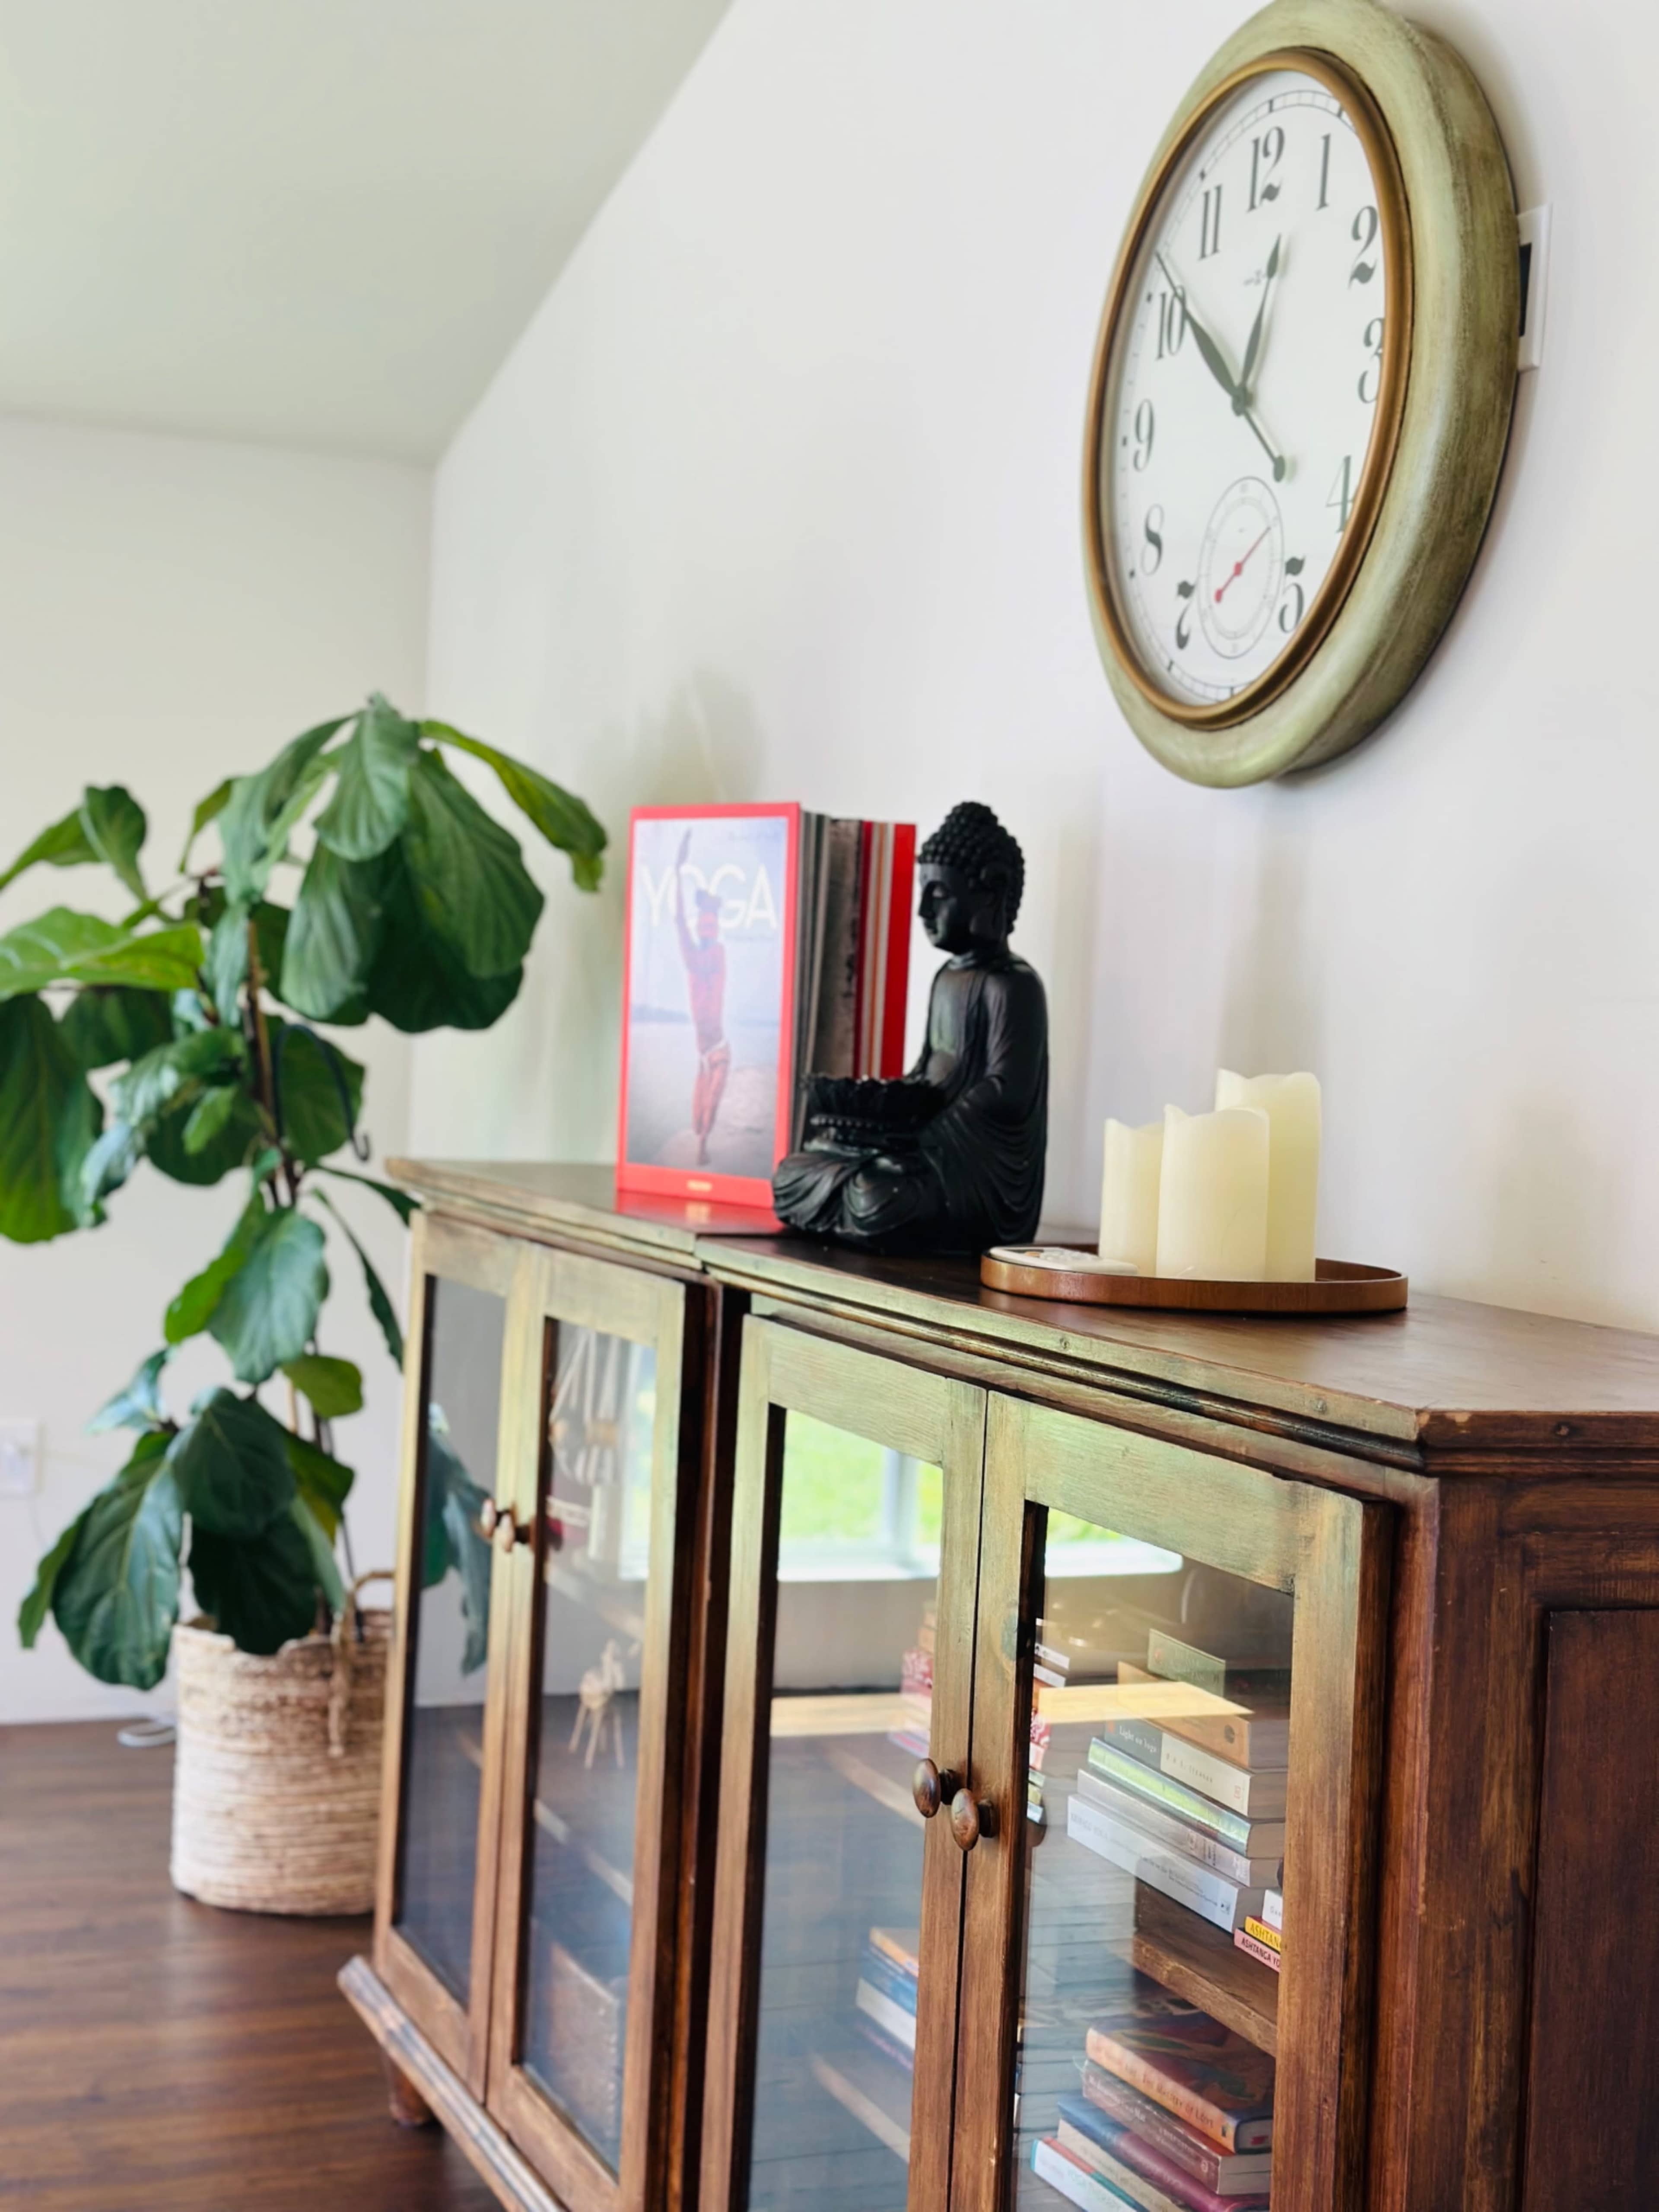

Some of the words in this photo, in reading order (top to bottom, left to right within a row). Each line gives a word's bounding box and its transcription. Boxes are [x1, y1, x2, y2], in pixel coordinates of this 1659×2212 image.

[1246, 125, 1286, 213] 12
[1315, 132, 1332, 211] 1
[1197, 183, 1223, 261] 11
[1348, 205, 1379, 290] 2
[1155, 285, 1187, 361] 10
[1357, 317, 1385, 404] 3
[1132, 398, 1155, 472] 9
[1325, 454, 1355, 534] 4
[1141, 504, 1164, 576] 8
[1175, 580, 1196, 650] 7
[1278, 556, 1306, 633] 5
[641, 864, 777, 930] YOGA
[1241, 1937, 1271, 1962] ASHTANGA
